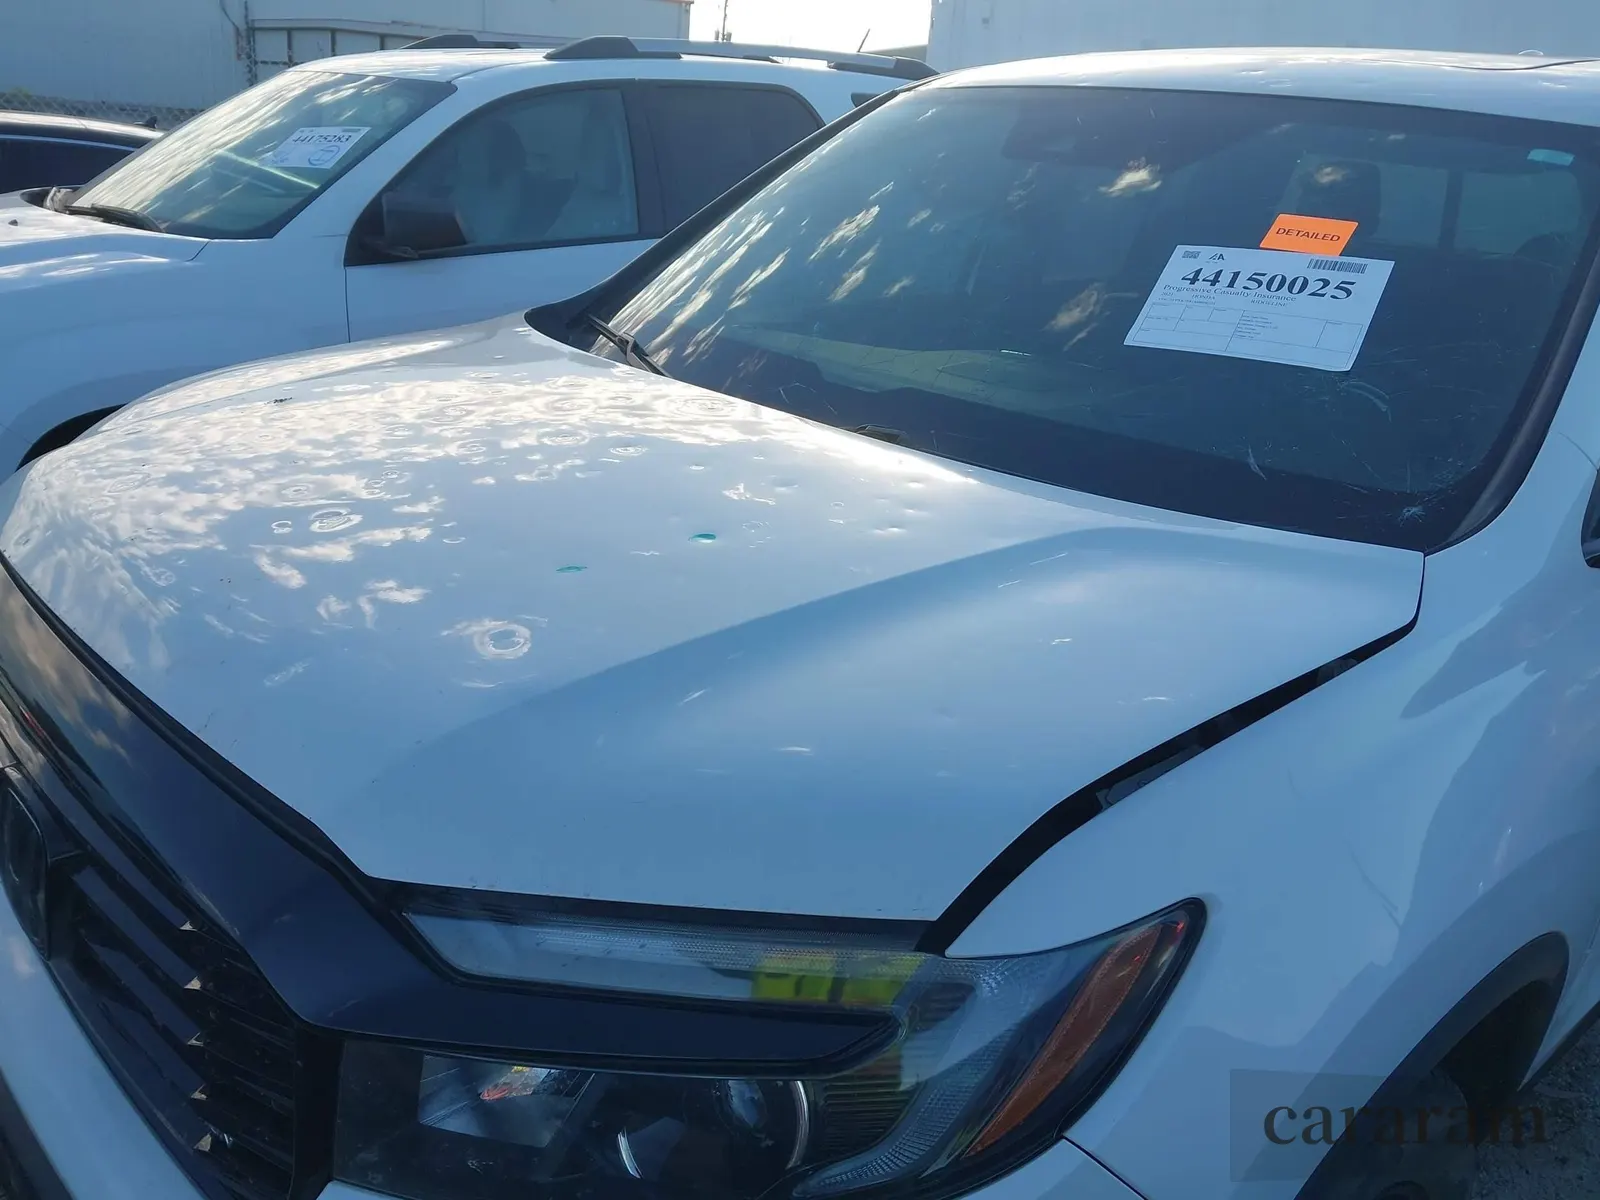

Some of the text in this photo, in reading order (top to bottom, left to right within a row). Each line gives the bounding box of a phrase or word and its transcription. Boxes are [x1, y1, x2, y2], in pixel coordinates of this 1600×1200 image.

[292, 133, 352, 144] 44175283
[1275, 226, 1341, 243] DETAILED
[1181, 267, 1356, 300] 44150025
[1163, 284, 1297, 302] Progressive Casualty Insurance
